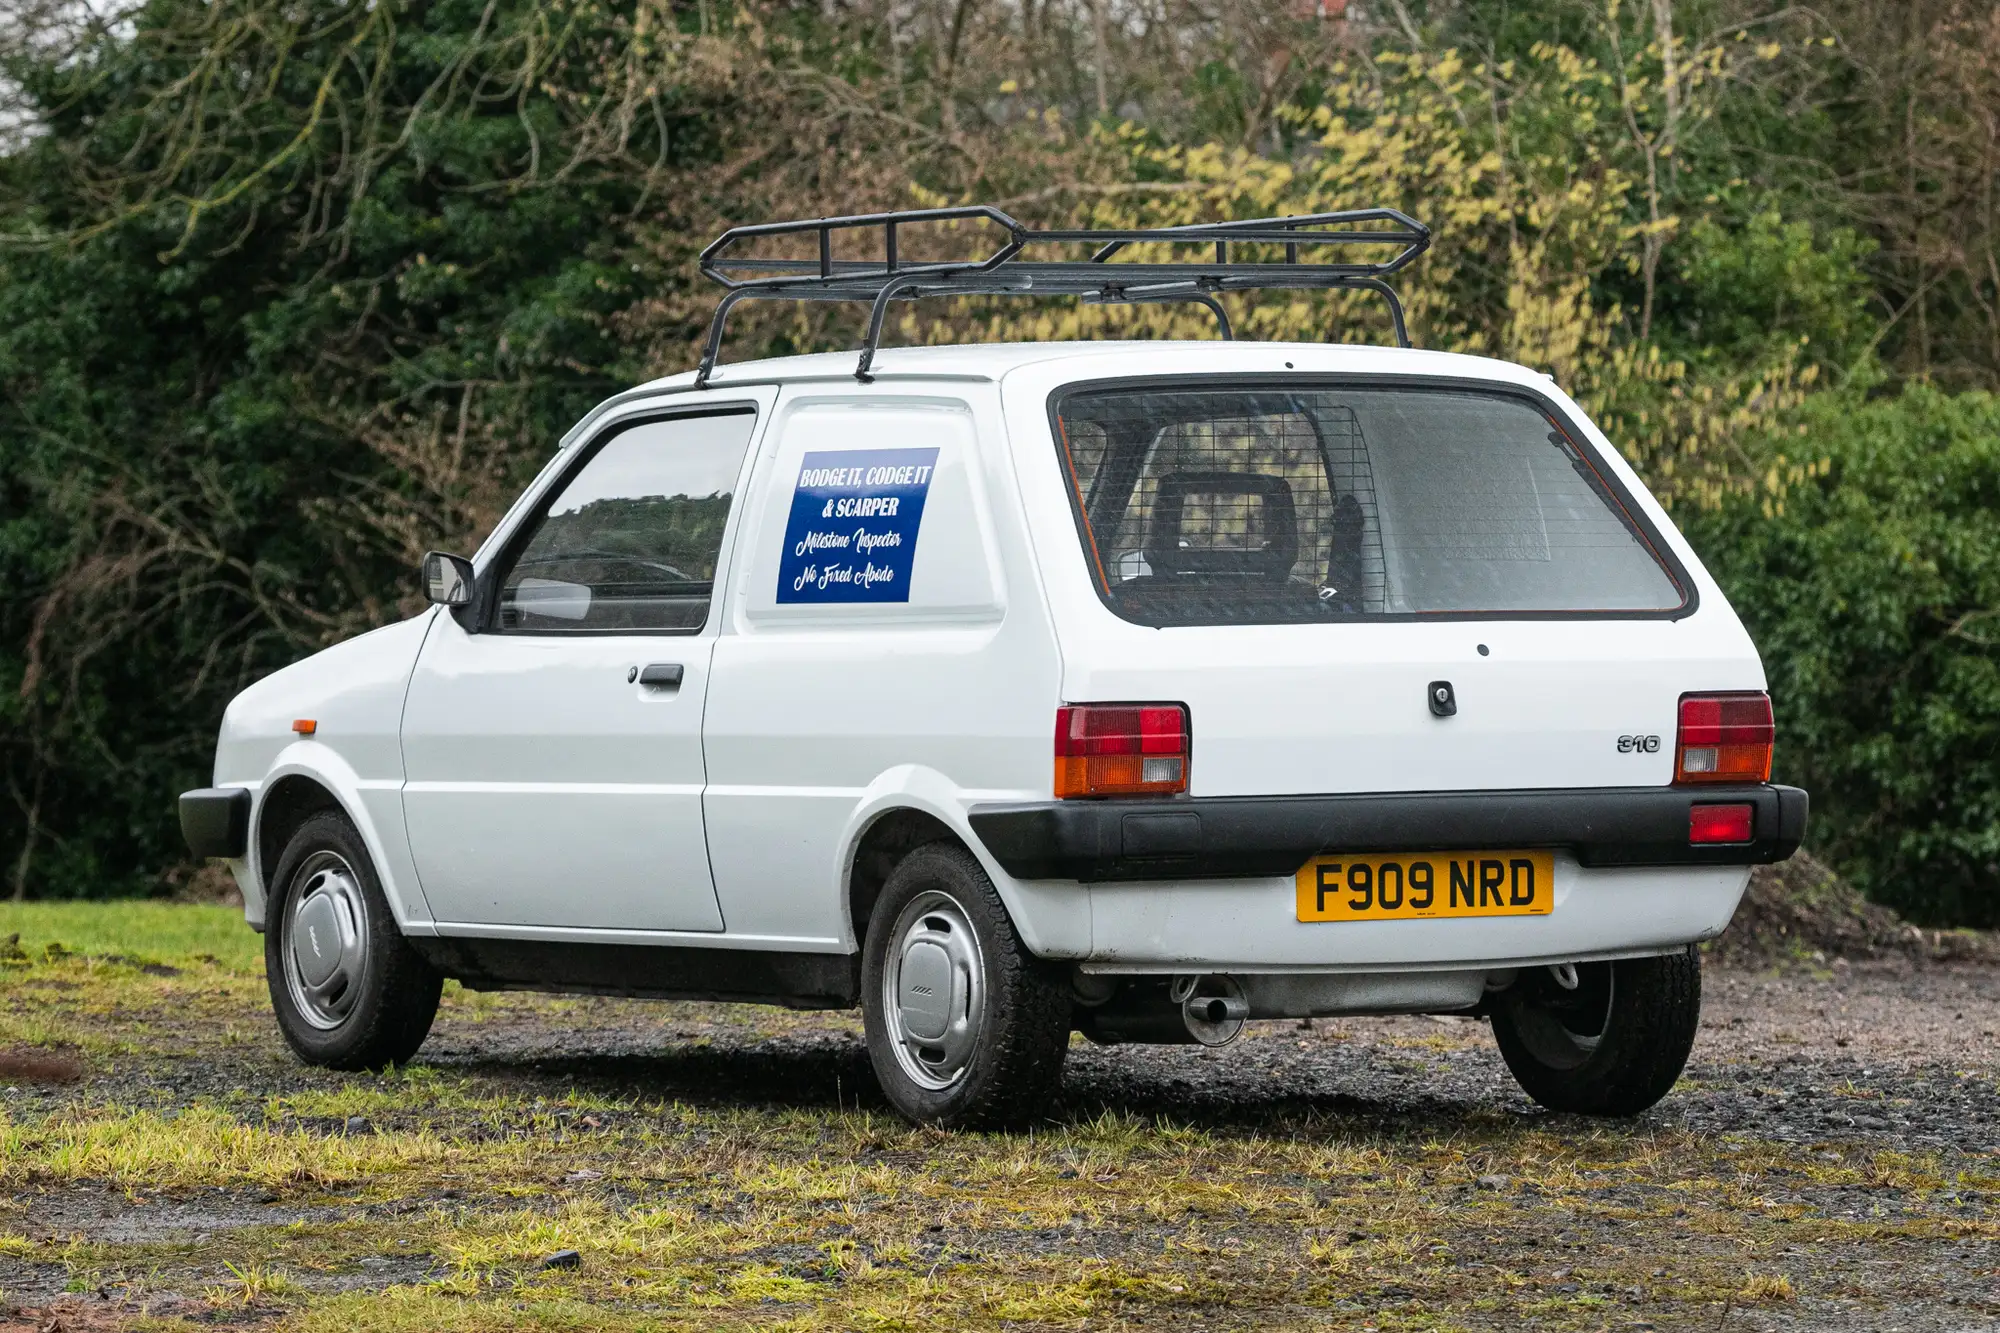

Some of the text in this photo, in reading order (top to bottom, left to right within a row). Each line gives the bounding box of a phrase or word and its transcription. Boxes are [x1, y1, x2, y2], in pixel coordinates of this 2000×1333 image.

[800, 468, 847, 487] BODGE
[866, 466, 913, 485] CODGE
[914, 465, 932, 484] IT
[822, 497, 899, 518] & SCARPER
[796, 527, 902, 556] Milestone Inspector
[794, 562, 894, 591] No Fixed Abode
[1617, 734, 1661, 753] 310
[1316, 858, 1535, 912] F909 NRD
